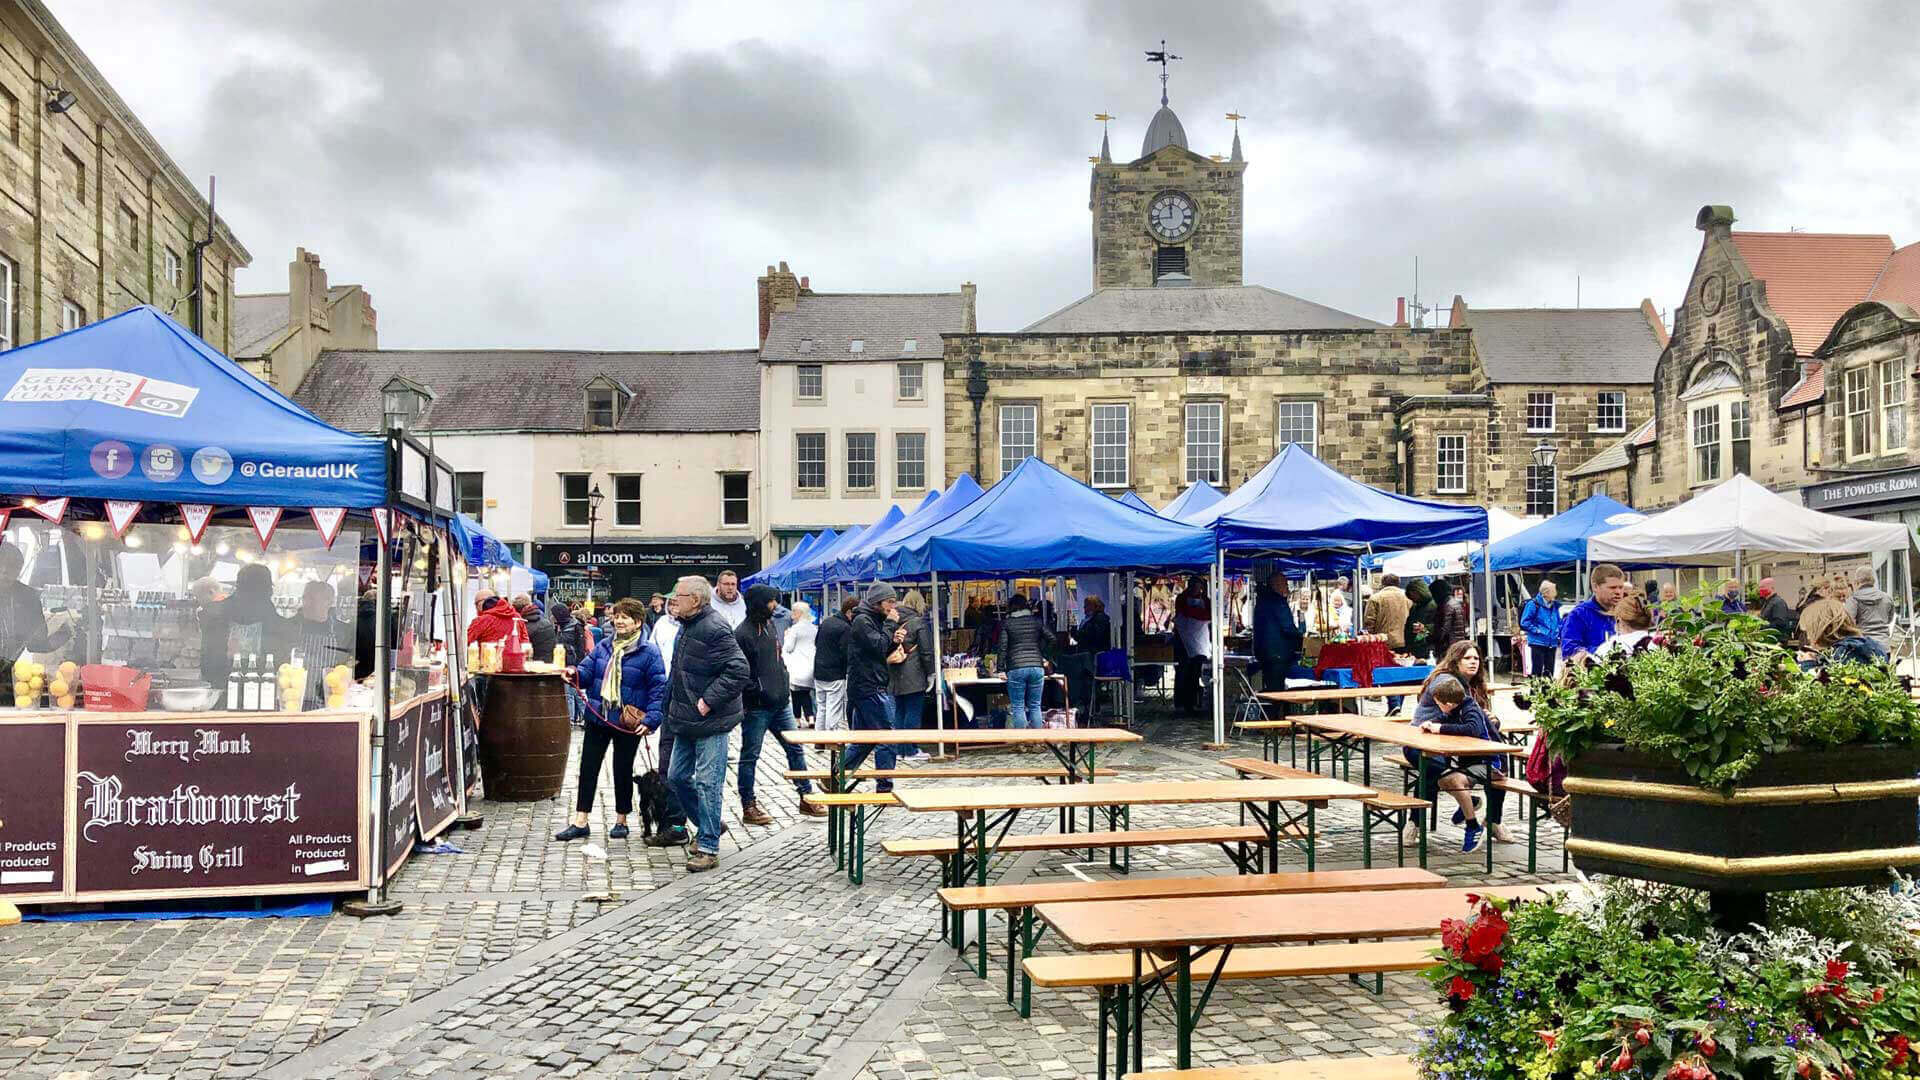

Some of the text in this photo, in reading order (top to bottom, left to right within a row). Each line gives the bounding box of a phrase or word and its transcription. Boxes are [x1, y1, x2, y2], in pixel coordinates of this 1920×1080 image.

[240, 461, 359, 479] @GeraudUK
[1823, 477, 1918, 501] THE POWDER ROOM
[577, 551, 634, 564] alncom
[125, 729, 251, 762] Merry Monk
[77, 771, 302, 843] Bratwurst
[4, 841, 57, 852] Products
[288, 834, 352, 845] All Products
[198, 843, 244, 874] Grill
[295, 848, 346, 859] Produced
[0, 855, 50, 868] roduced
